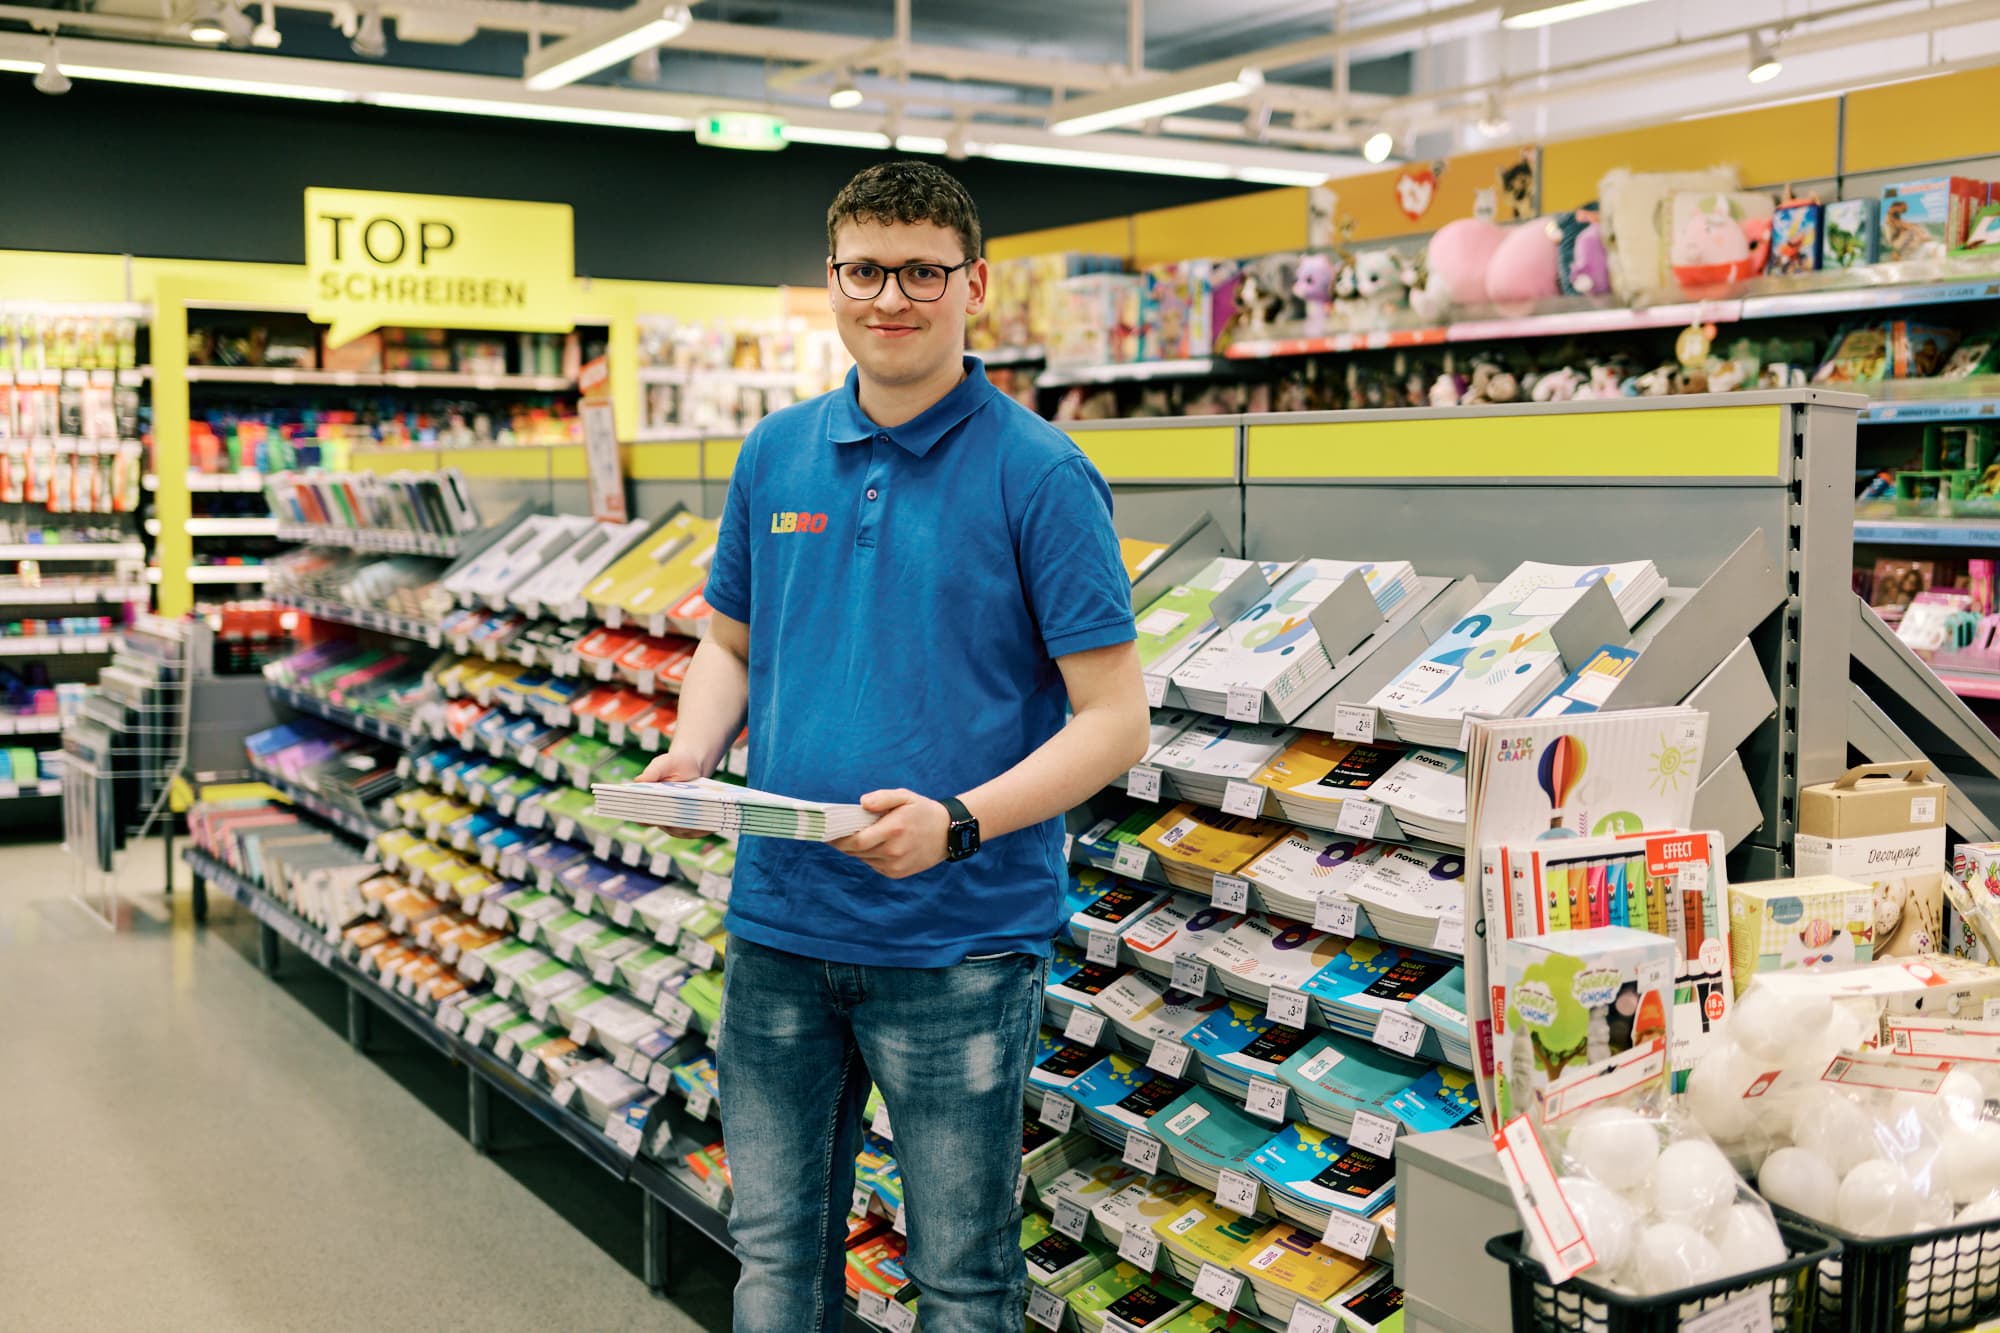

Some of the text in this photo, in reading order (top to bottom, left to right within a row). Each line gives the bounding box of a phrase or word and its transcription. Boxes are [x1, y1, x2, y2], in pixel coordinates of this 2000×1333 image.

[320, 214, 455, 265] TOP
[320, 271, 526, 308] SCHREIBEN
[771, 512, 828, 534] LIBRO
[1501, 737, 1533, 750] BASIC
[1497, 749, 1534, 762] CRAFT
[1662, 841, 1693, 860] EFFECT
[1868, 845, 1921, 866] Decoupage
